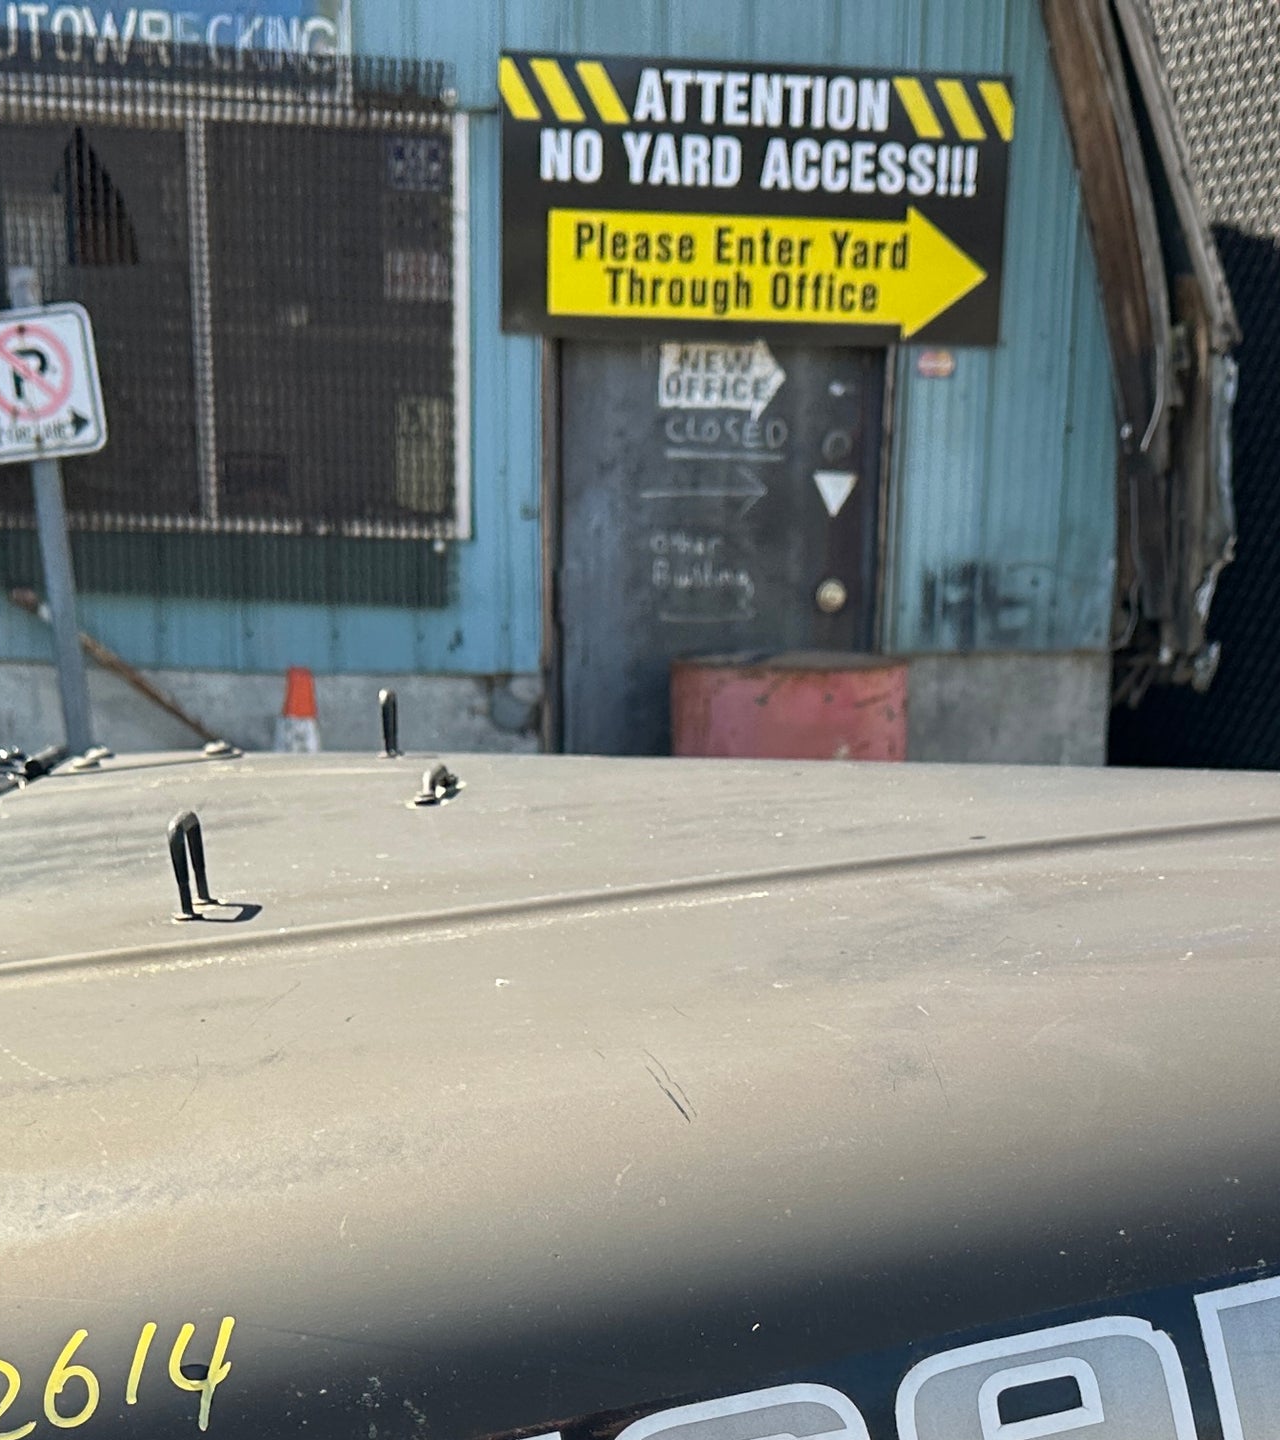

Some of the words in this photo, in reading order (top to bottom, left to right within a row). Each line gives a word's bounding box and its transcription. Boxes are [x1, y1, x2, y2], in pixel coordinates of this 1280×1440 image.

[633, 68, 890, 132] ATTENTION
[540, 128, 604, 183] NO
[622, 131, 742, 188] YARD
[759, 137, 978, 197] ACCESS!!!
[573, 222, 694, 264] Please
[713, 226, 812, 268] Enter
[829, 230, 910, 272] Yard
[604, 266, 753, 316] Through
[769, 272, 879, 311] Office
[678, 348, 753, 374] NEW
[665, 372, 769, 402] OFFICE
